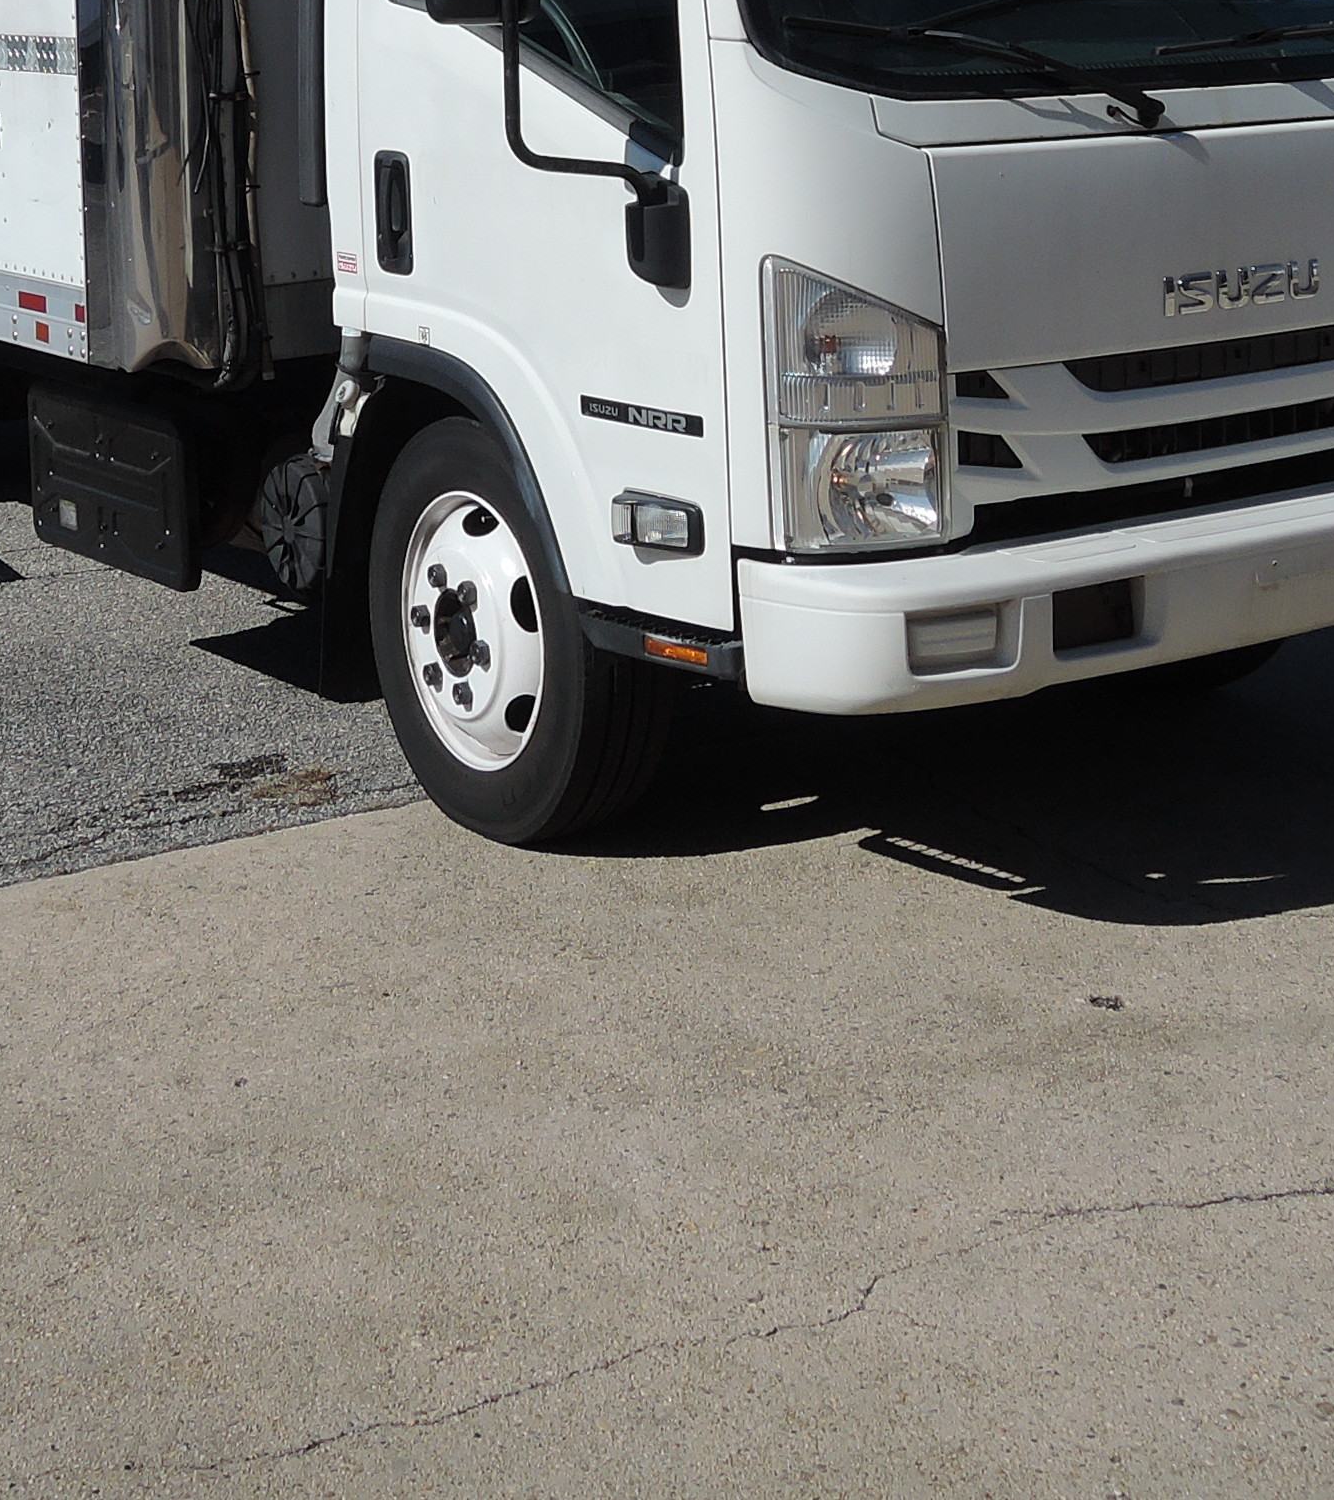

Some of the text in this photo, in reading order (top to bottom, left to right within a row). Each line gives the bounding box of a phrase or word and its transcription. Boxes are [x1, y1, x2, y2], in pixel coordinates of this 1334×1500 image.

[1163, 258, 1320, 317] ISUZU
[589, 402, 686, 432] ISUZU NRR
